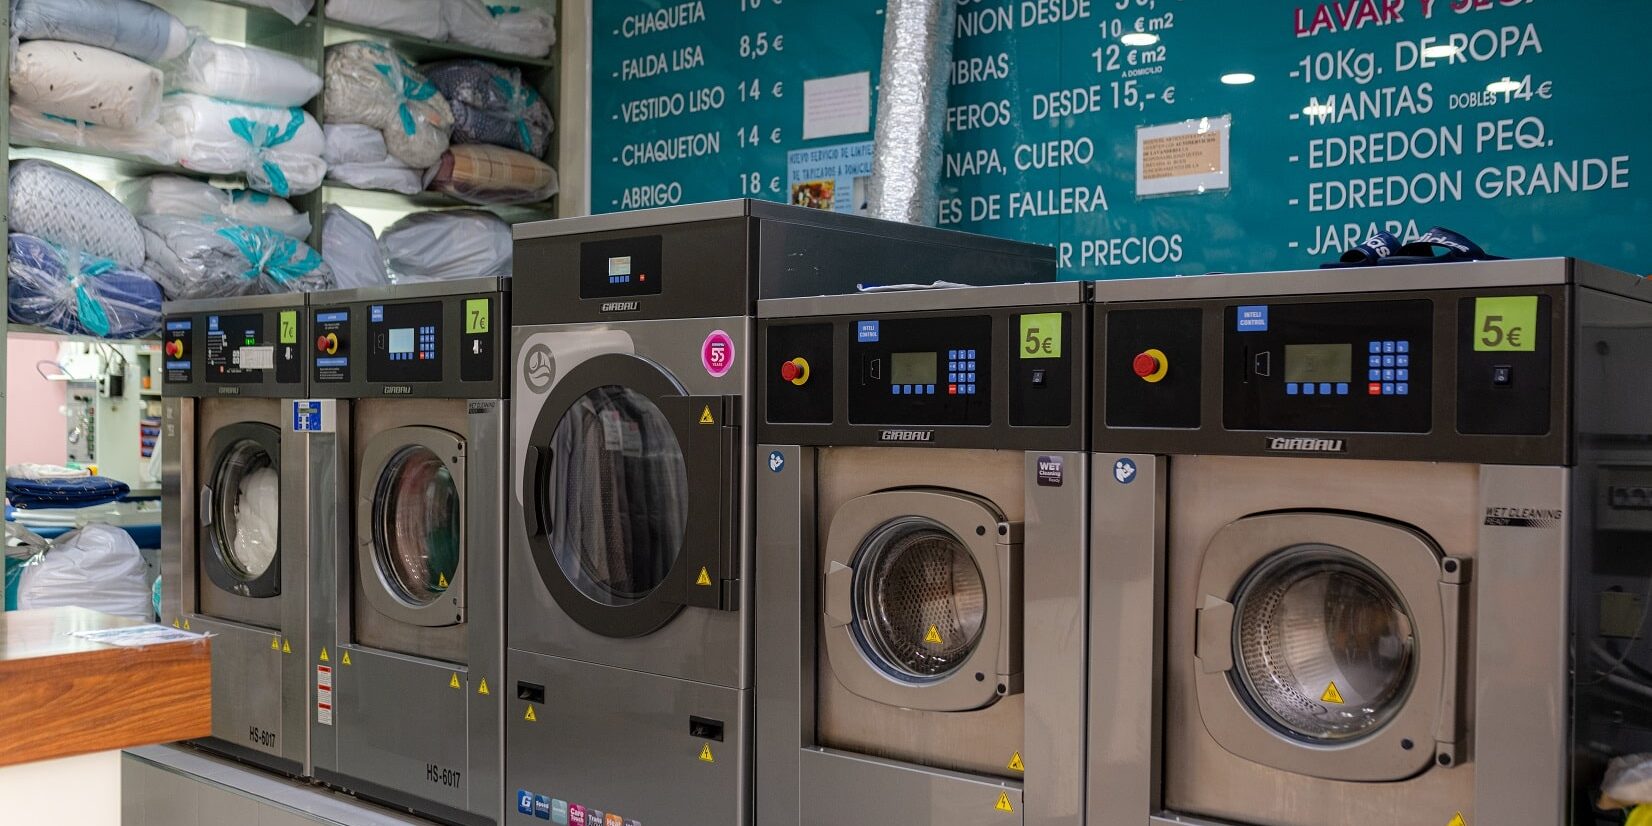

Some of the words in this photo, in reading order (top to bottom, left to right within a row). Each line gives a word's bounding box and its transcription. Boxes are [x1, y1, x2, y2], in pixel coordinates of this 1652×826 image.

[622, 1, 705, 38] CHAQUETA
[958, 6, 1012, 38] NION
[1022, 0, 1090, 27] DESDE
[1100, 20, 1120, 38] 10
[1149, 13, 1174, 31] m2
[1294, 0, 1403, 37] LAVAR
[740, 33, 768, 59] 8,5
[1396, 36, 1436, 72] DE
[1449, 23, 1542, 64] ROPA
[622, 54, 668, 80] FALDA
[674, 46, 704, 70] LISA
[952, 53, 1008, 85] BRAS
[1092, 44, 1120, 72] 12
[1142, 46, 1166, 63] m2
[1128, 65, 1163, 77] DOMICILIO
[738, 79, 760, 102] 14
[622, 94, 684, 122] VESTIDO
[690, 86, 724, 112] LISO
[946, 100, 1010, 132] FEROS
[1033, 85, 1100, 120] DESDE
[1310, 82, 1433, 126] MANTAS
[1449, 90, 1496, 110] DOBLES
[622, 132, 720, 166] CHAQUETON
[737, 125, 759, 148] 14
[1309, 125, 1462, 169] EDREDON
[1477, 117, 1553, 153] PEQ.
[851, 143, 874, 157] LIMPIE
[946, 149, 1007, 178] NAPA,
[1014, 137, 1094, 171] CUERO
[845, 162, 873, 175] DOMICILI
[622, 182, 682, 209] ABRIGO
[740, 172, 760, 195] 18
[1309, 170, 1462, 212] EDREDON
[1475, 155, 1629, 198] GRANDE
[939, 199, 962, 224] ES
[971, 195, 1000, 222] DE
[1009, 185, 1108, 218] FALLERA
[1081, 234, 1183, 267] PRECIOS
[602, 302, 638, 311] GIRBAU
[711, 348, 724, 362] 55
[882, 430, 931, 440] GIRBAU
[1271, 439, 1342, 451] GIRBAU
[1040, 462, 1061, 470] WET
[1486, 507, 1508, 517] WET
[1509, 508, 1562, 519] CLEANING
[250, 726, 276, 748] HS-6017
[427, 763, 460, 789] HS-6017
[522, 796, 531, 808] G
[570, 808, 584, 817] Care
